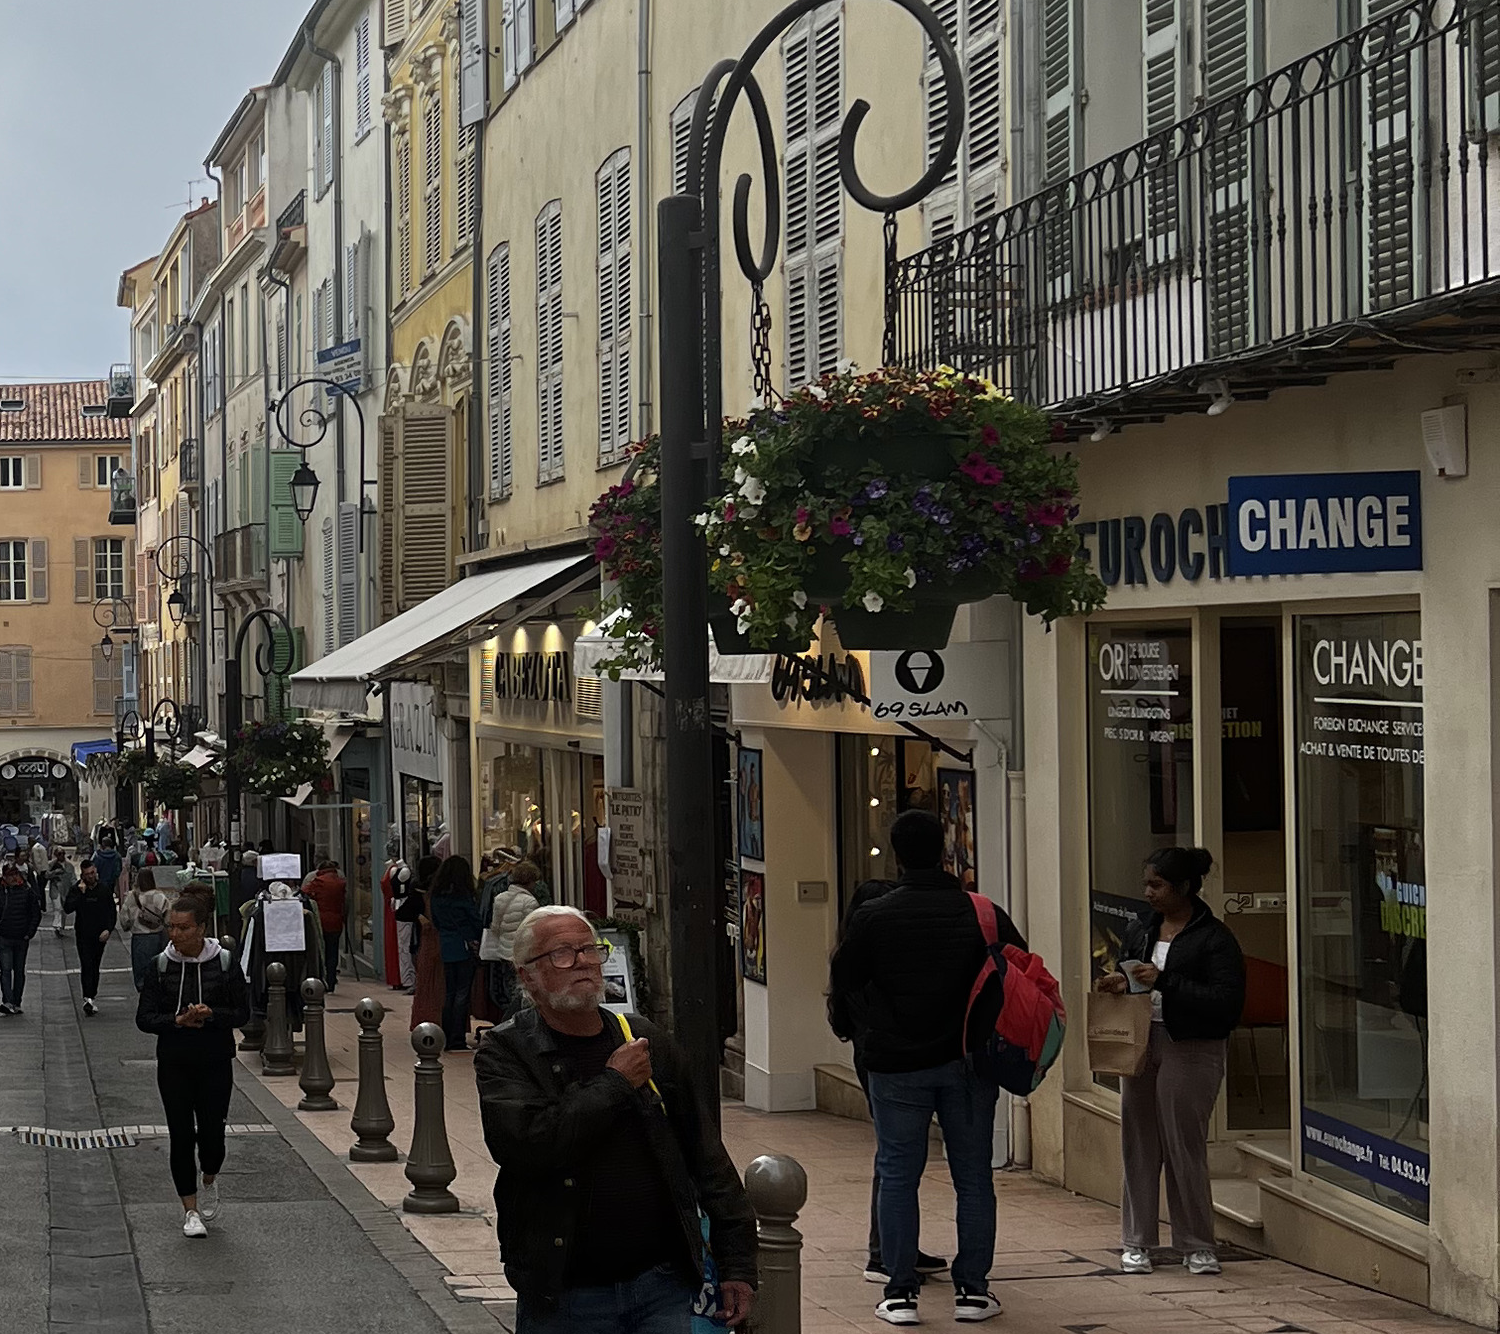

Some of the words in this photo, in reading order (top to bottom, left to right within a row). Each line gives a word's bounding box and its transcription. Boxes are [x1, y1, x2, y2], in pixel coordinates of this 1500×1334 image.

[1238, 495, 1411, 552] CHANGE
[1099, 643, 1124, 681] OR
[1313, 639, 1424, 687] CHANGE
[874, 702, 904, 718] 69
[908, 701, 968, 717] SLAM
[1313, 717, 1345, 731] FOREIGN
[1347, 718, 1389, 735] EXCHANGE
[1300, 742, 1327, 756] ACHAT
[1328, 743, 1335, 757] &
[1335, 744, 1362, 759] VENTE
[1363, 746, 1375, 760] DE
[1377, 747, 1410, 763] TOUTES
